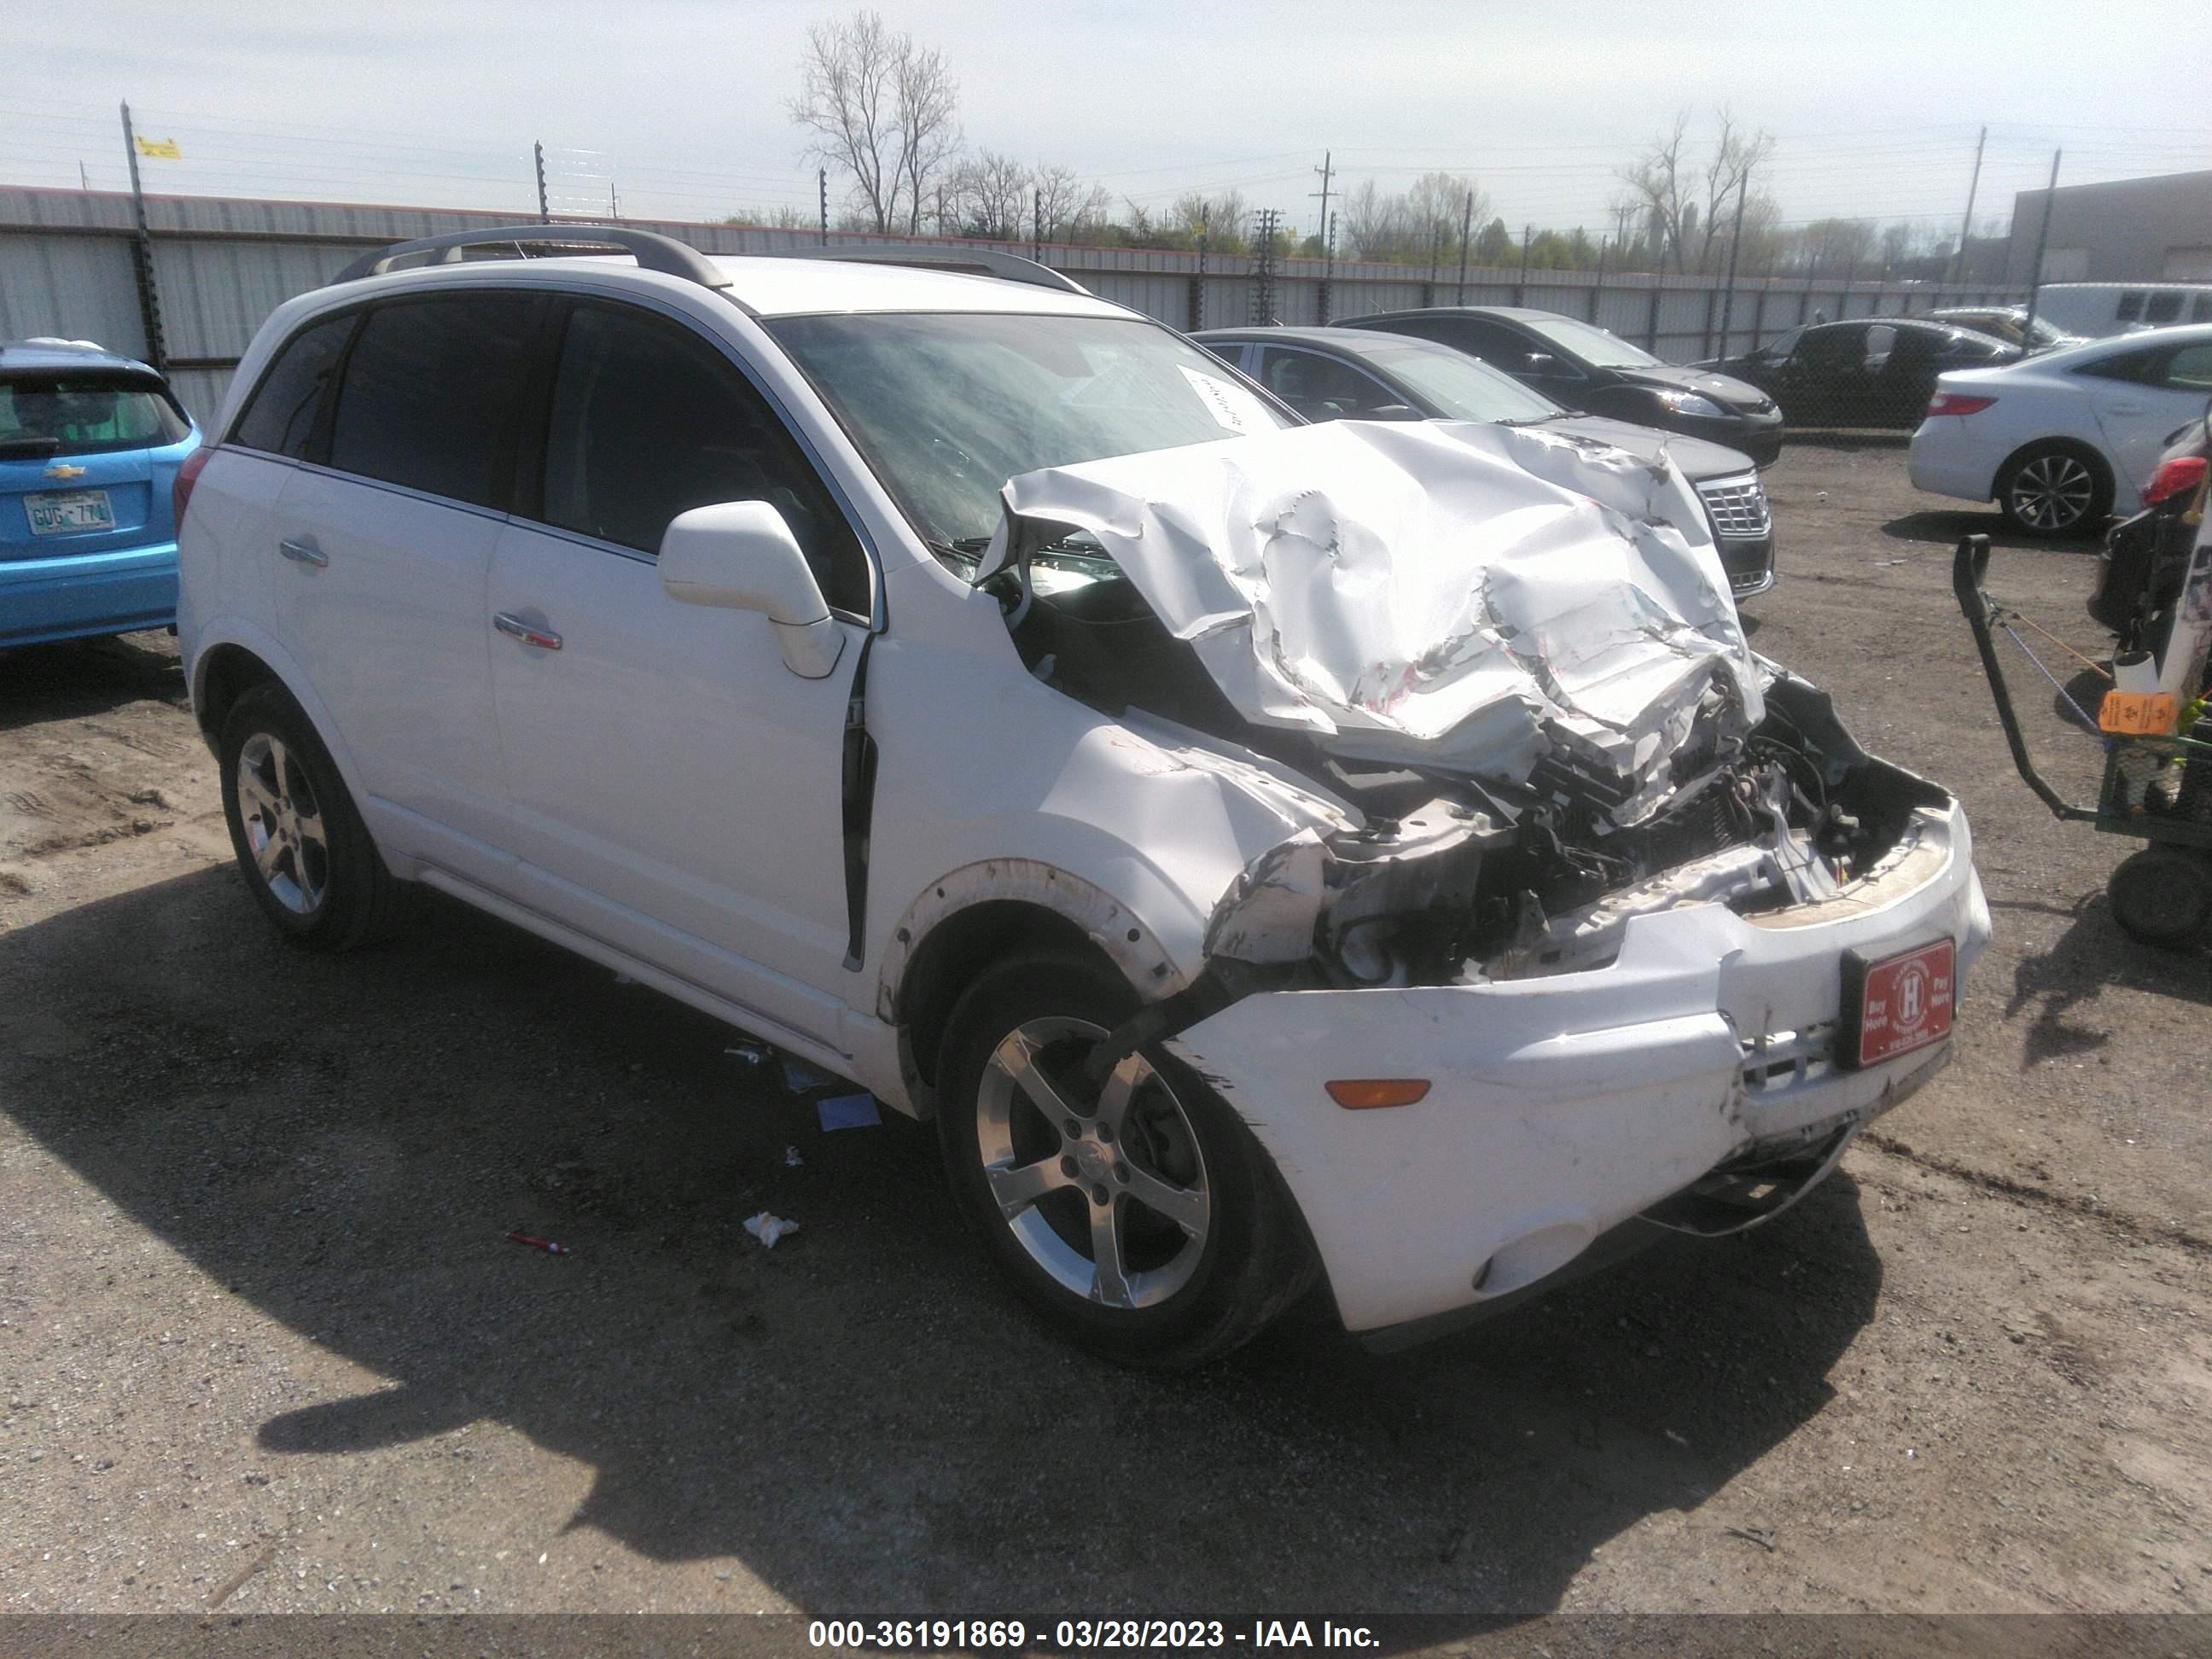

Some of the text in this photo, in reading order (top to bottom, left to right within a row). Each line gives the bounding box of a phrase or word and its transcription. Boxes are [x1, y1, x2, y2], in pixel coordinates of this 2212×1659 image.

[1933, 976, 1948, 991] Pay
[1902, 975, 1921, 1018] H
[1930, 992, 1950, 1008] Here
[1869, 999, 1887, 1015] Buy
[1866, 1015, 1888, 1033] Here
